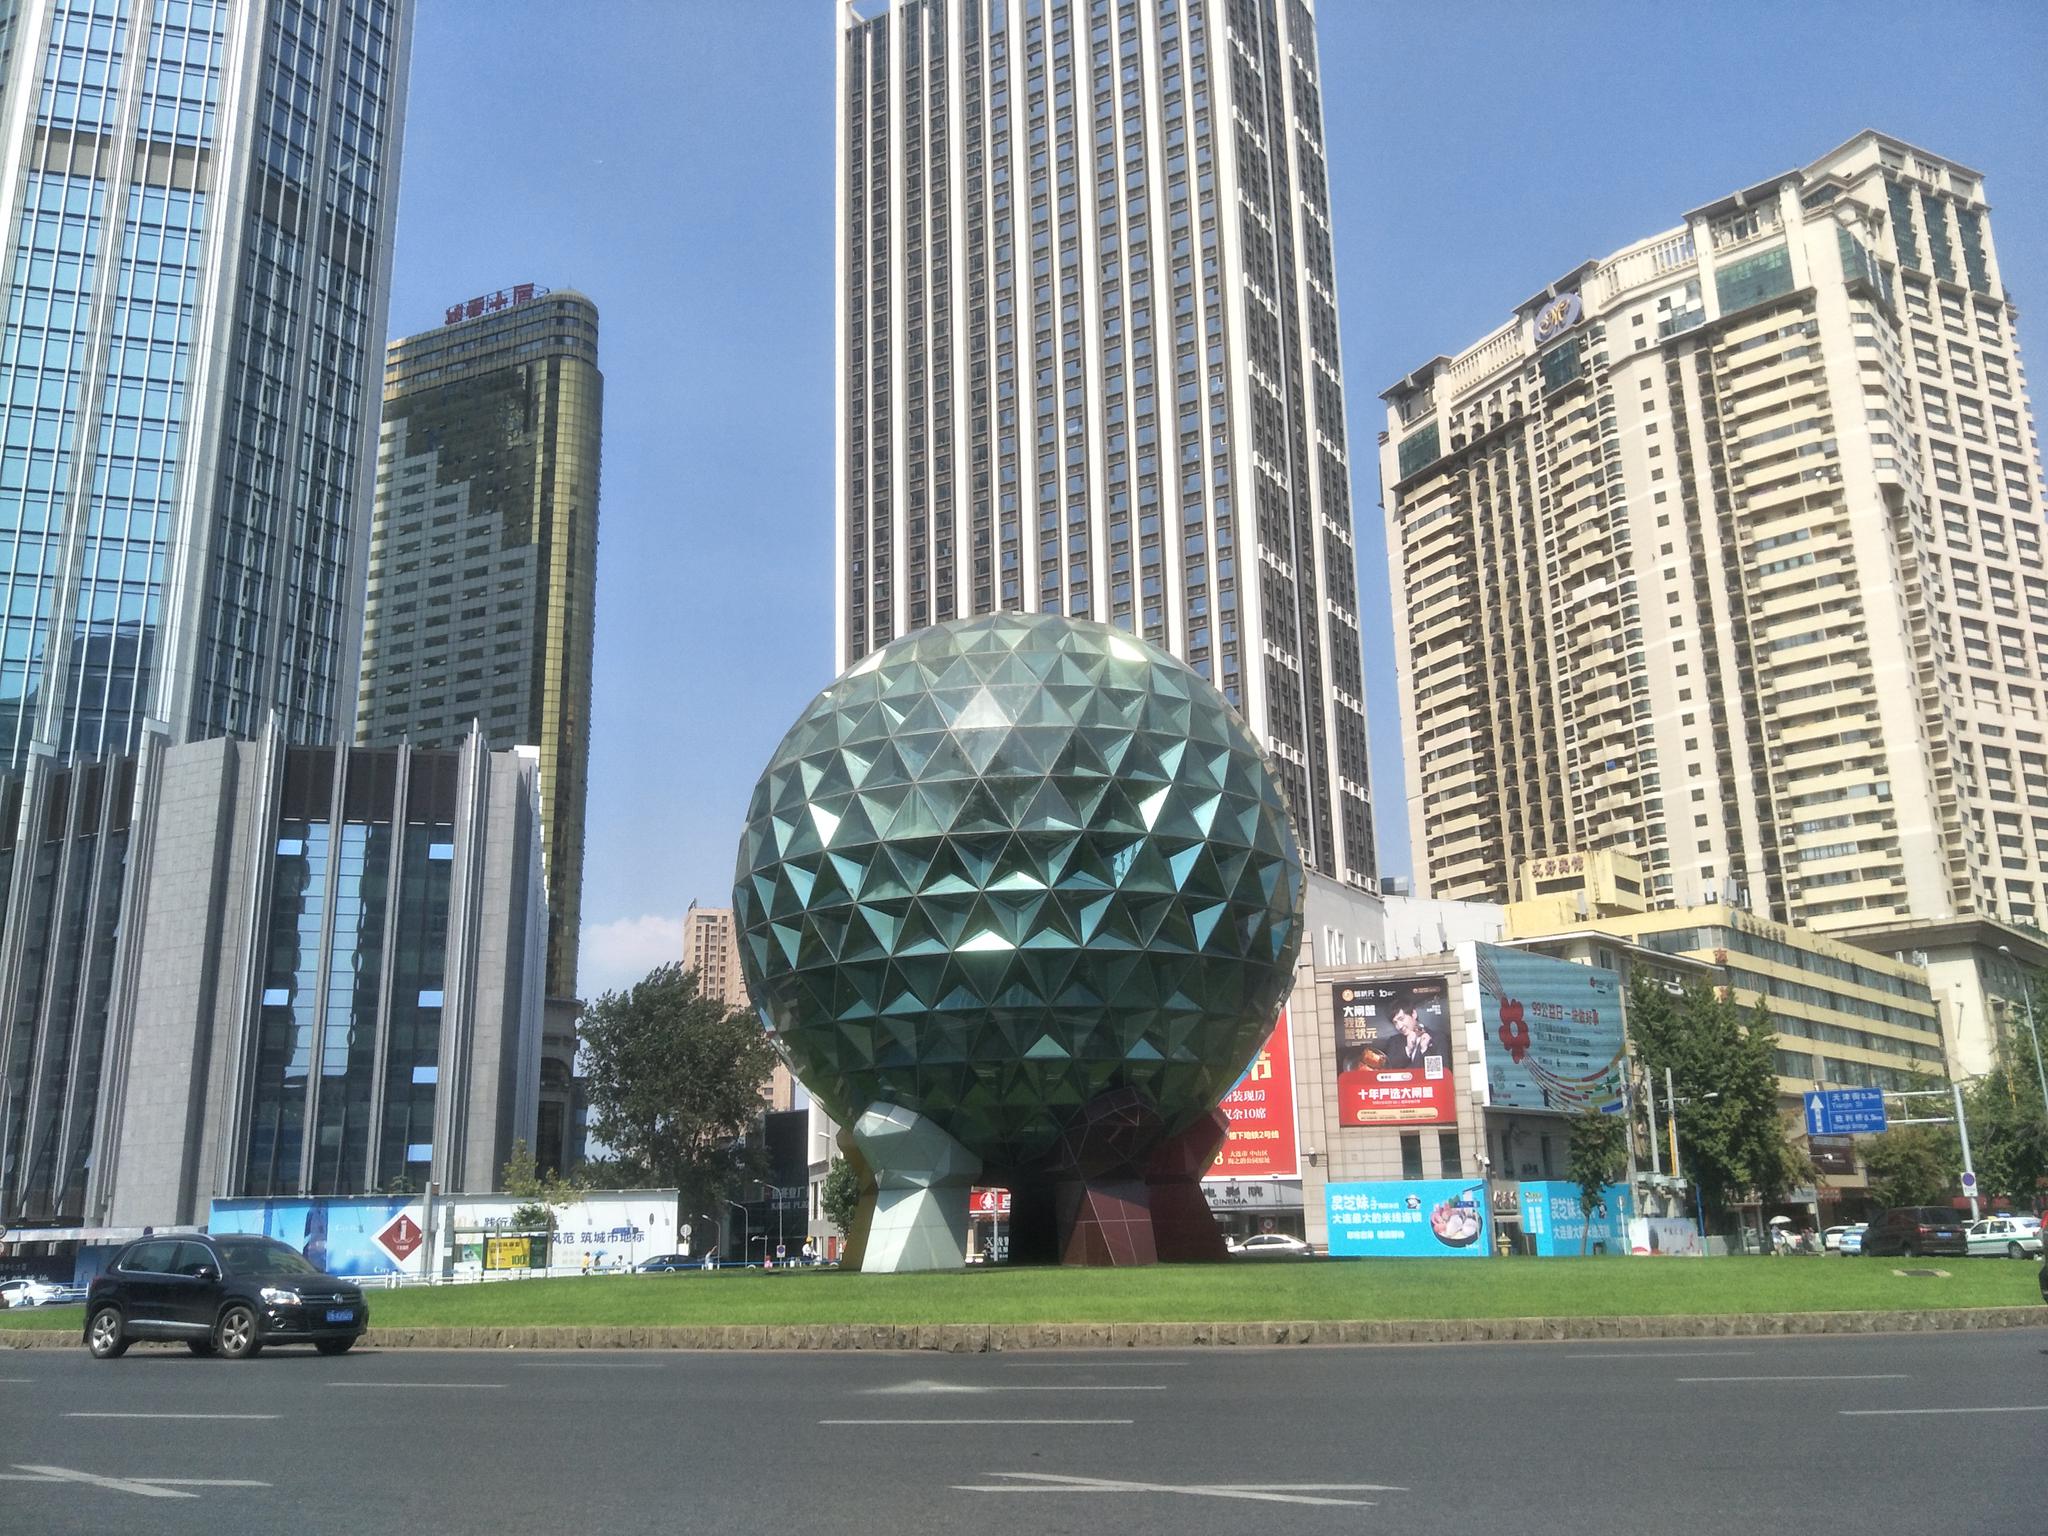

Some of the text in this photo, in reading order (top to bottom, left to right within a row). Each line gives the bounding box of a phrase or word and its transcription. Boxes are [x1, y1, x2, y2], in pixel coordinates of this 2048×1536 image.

[1343, 1005, 1376, 1017] 大闸蟹
[1344, 1028, 1378, 1040] 蟹状元
[1358, 1086, 1434, 1100] 十年严选大闸蟹
[580, 1231, 645, 1244] 筑城市地标
